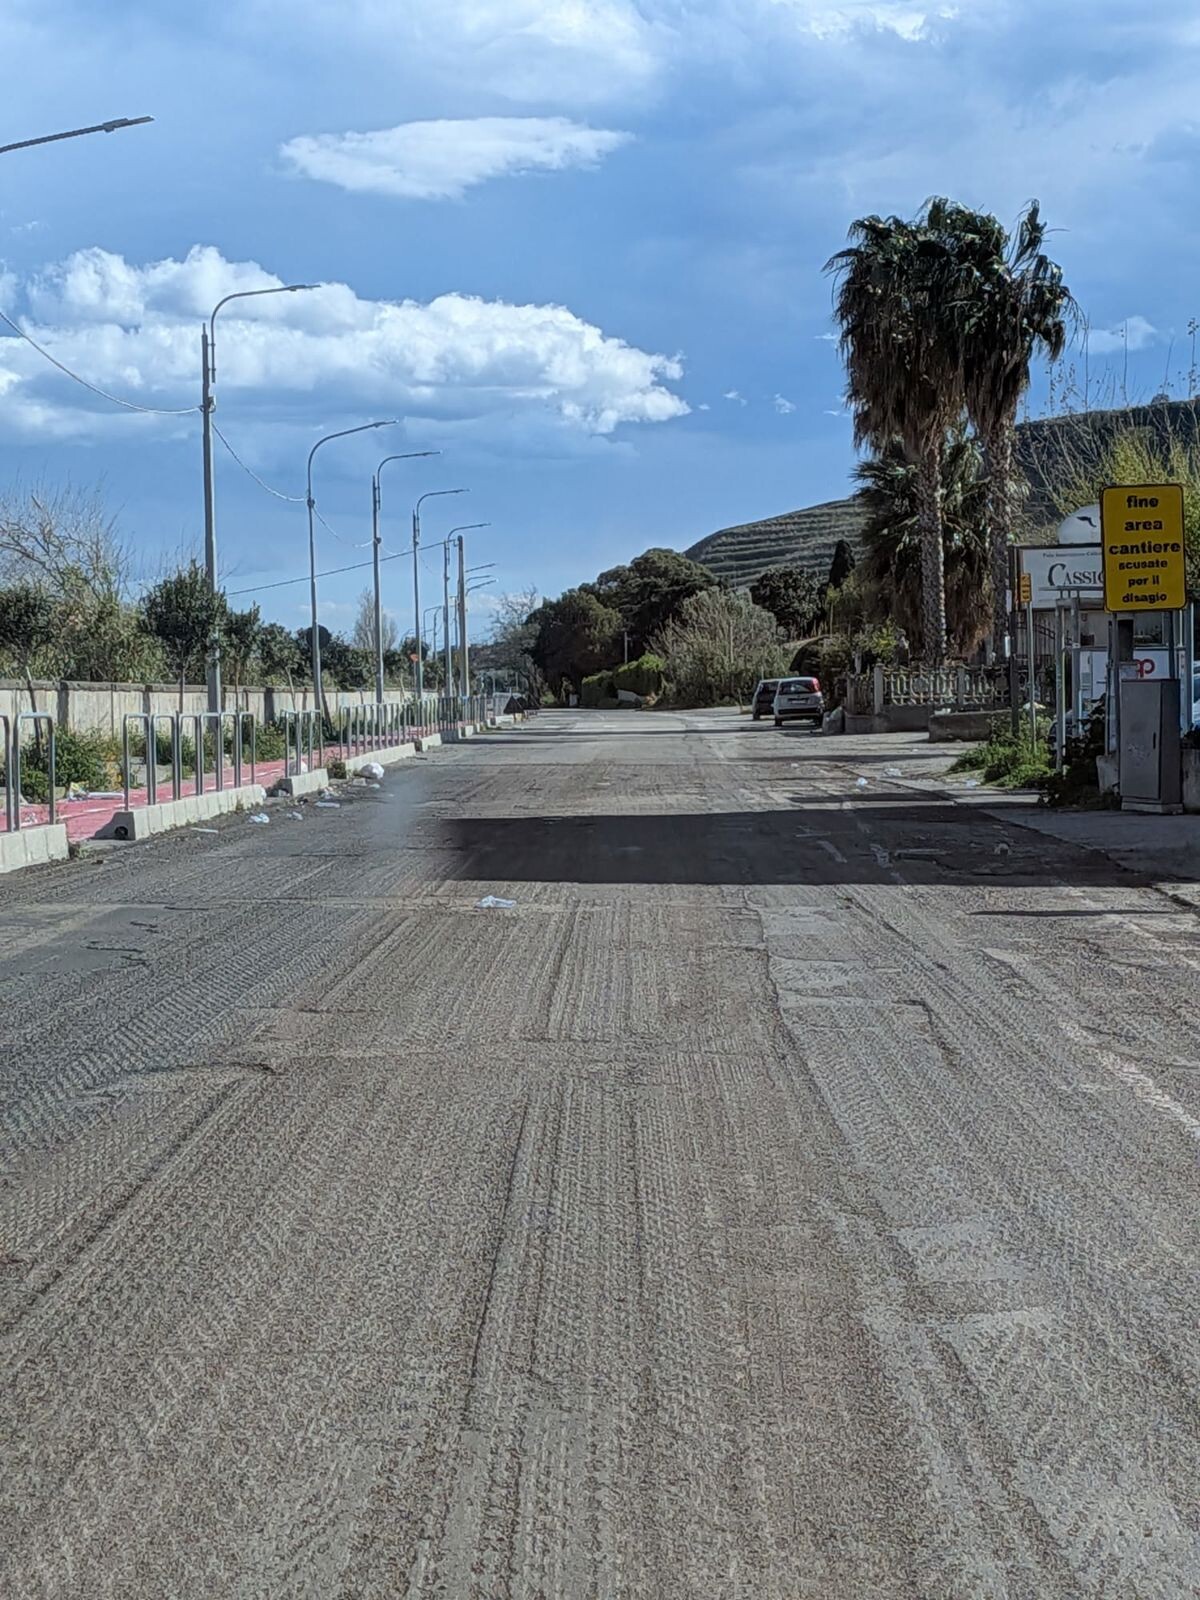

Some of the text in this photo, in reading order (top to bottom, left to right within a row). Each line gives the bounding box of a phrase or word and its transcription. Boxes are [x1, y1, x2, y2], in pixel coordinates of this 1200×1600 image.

[1127, 495, 1159, 508] fine
[1125, 520, 1163, 531] area
[1109, 541, 1181, 555] cantiere
[1119, 560, 1168, 570] scusate
[1128, 575, 1160, 587] per il
[1122, 593, 1167, 604] disagio
